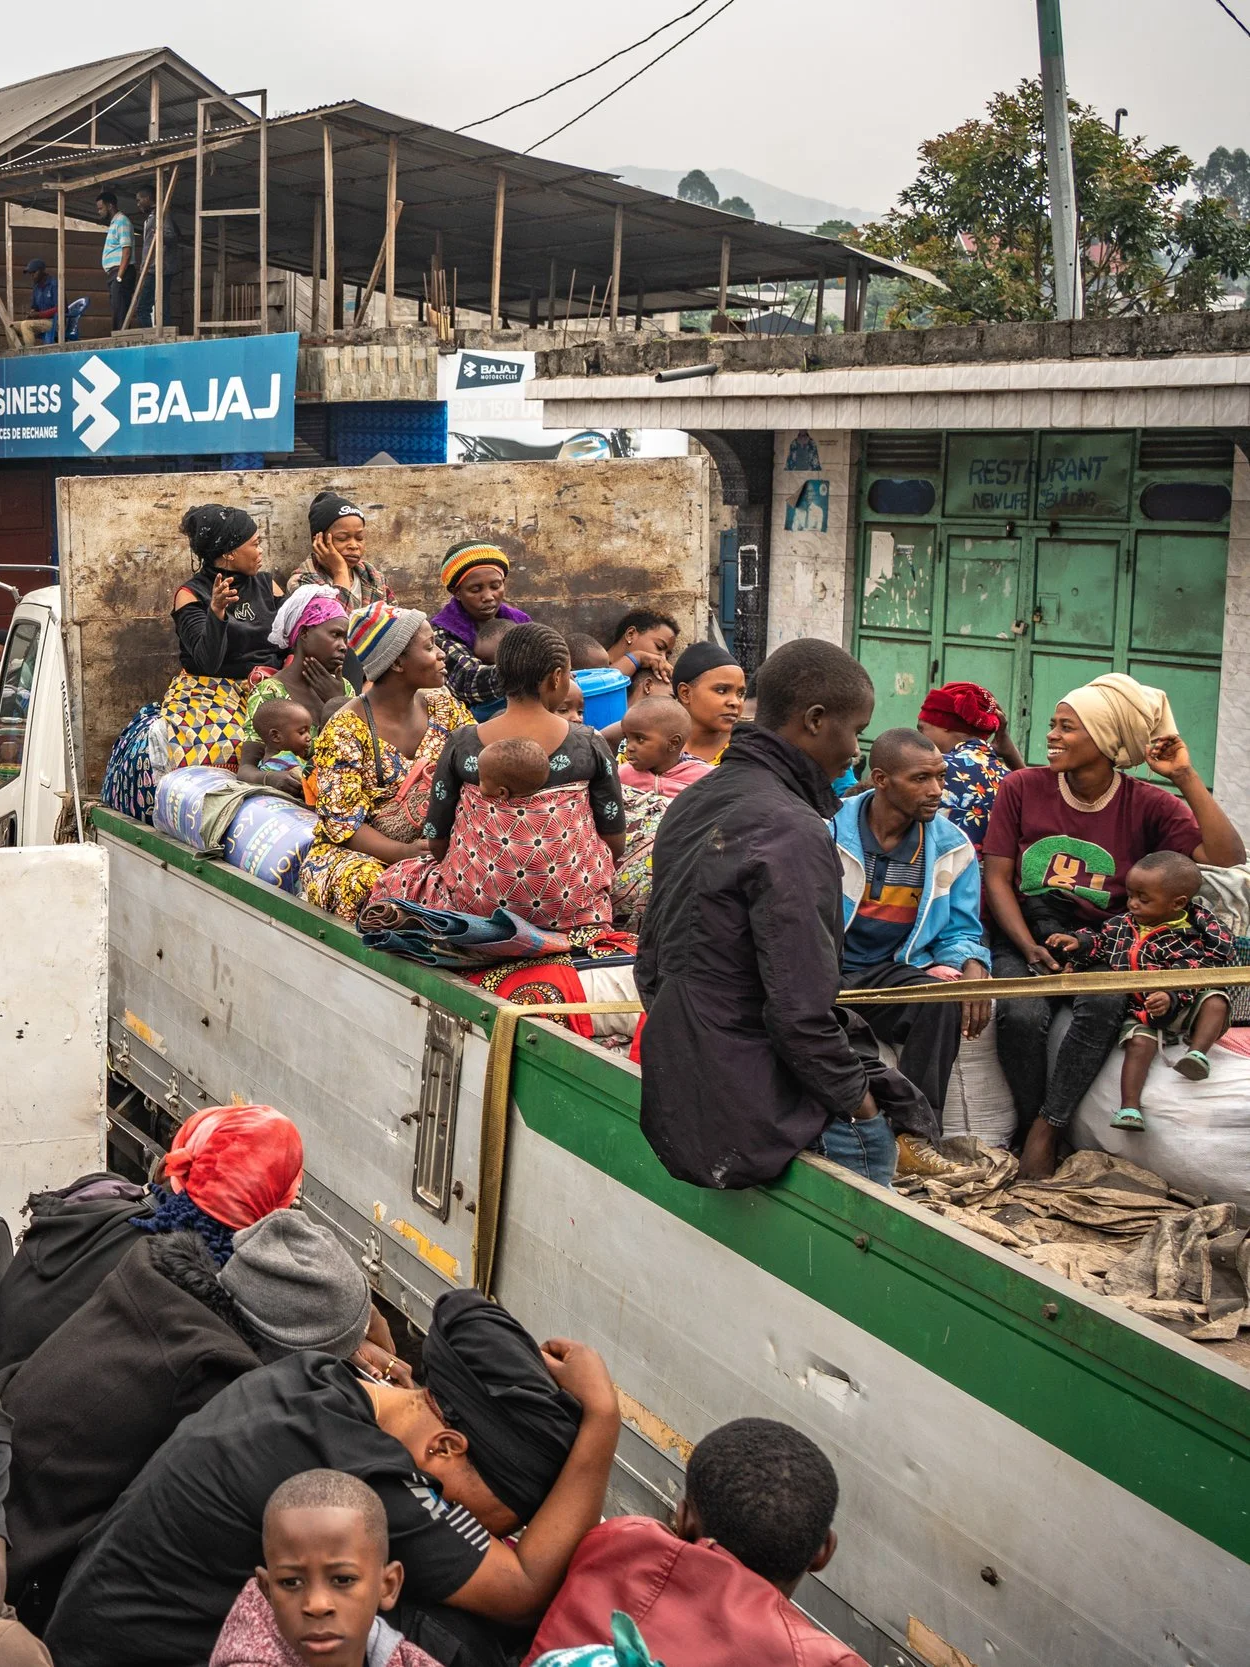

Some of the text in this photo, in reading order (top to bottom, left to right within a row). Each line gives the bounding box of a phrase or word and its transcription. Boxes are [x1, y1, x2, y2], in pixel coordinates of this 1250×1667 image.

[480, 364, 518, 375] BAJAJ
[130, 373, 281, 425] BAJAJ
[12, 427, 21, 439] DE
[22, 426, 58, 439] RECHANGE
[968, 456, 1109, 485] RESTAURANT
[227, 809, 253, 854] JOY
[269, 841, 303, 888] JOY
